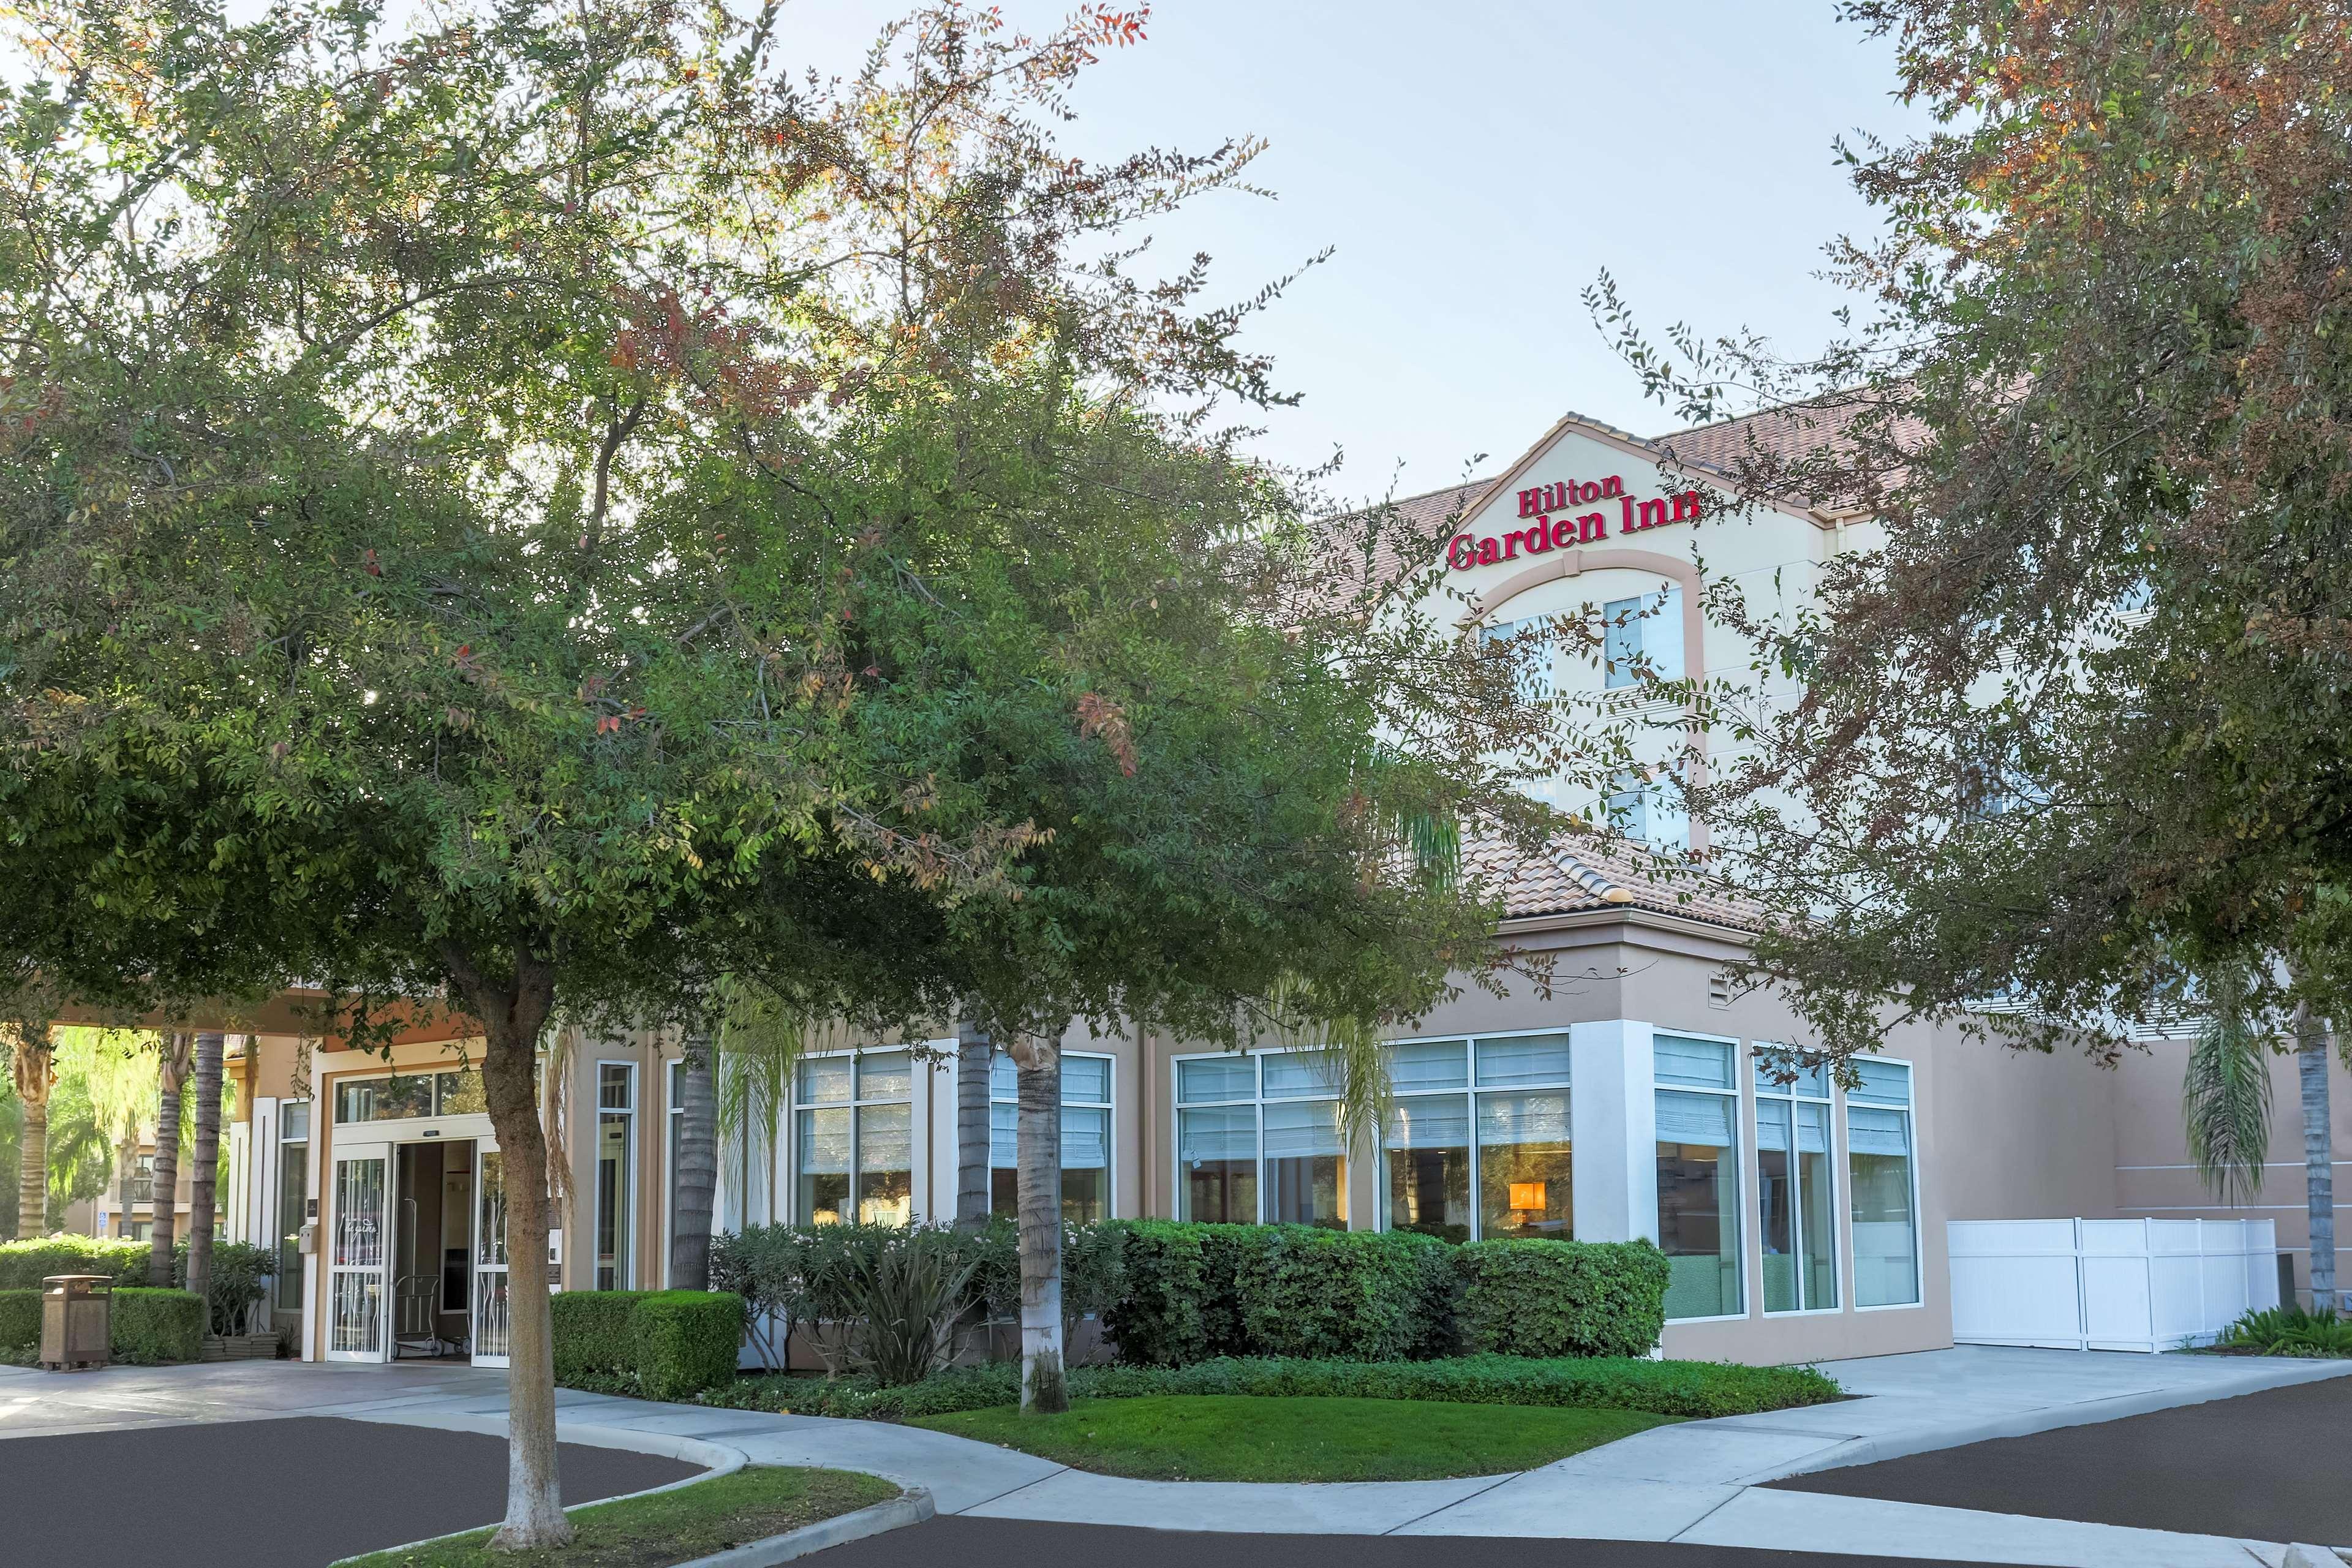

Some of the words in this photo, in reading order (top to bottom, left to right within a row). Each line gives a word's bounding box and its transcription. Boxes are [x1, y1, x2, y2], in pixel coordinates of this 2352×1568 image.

[1517, 475, 1626, 518] Hilton
[1448, 512, 1609, 571] Garden
[1618, 490, 1702, 534] Inn
